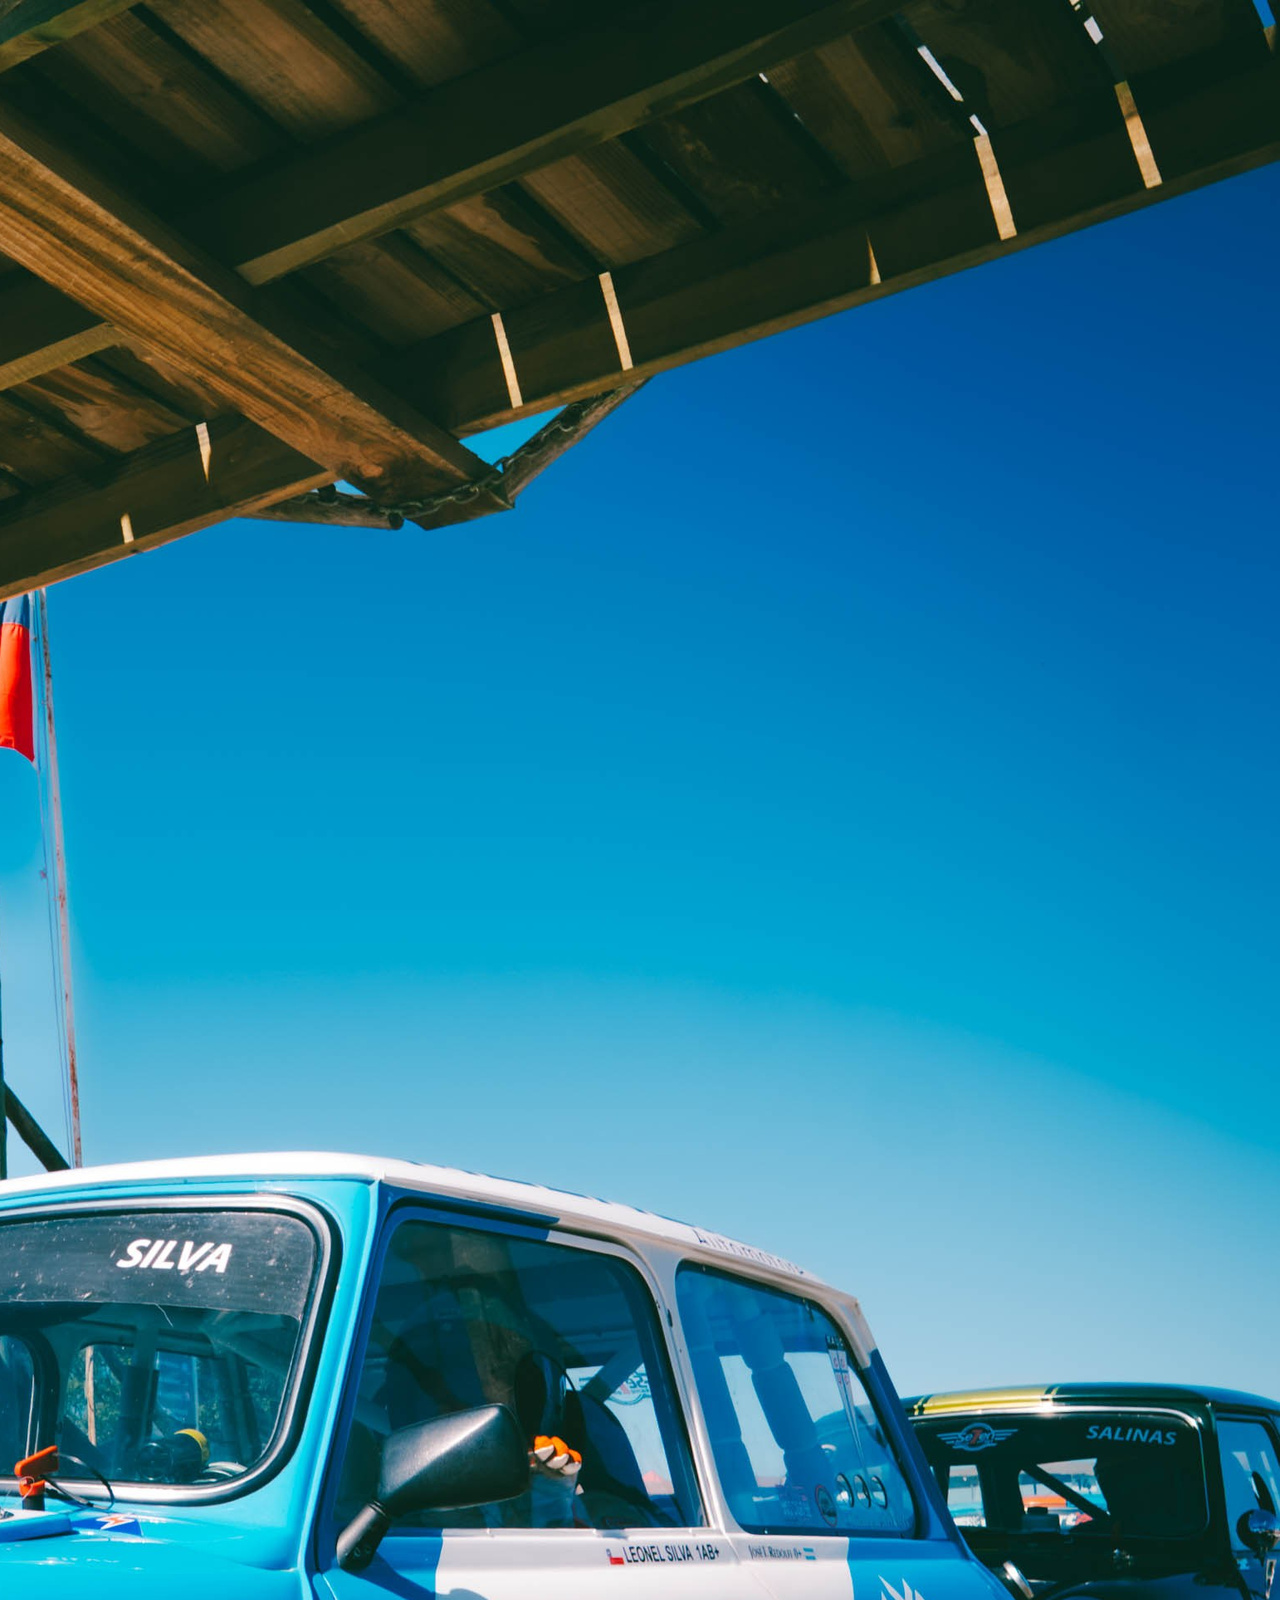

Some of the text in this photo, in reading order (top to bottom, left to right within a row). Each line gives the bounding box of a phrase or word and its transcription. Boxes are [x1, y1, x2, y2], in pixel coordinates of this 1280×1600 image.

[115, 1238, 232, 1273] SILVA
[1085, 1424, 1177, 1445] SALINAS
[622, 1543, 720, 1563] LEONEL SILVA 1AB+
